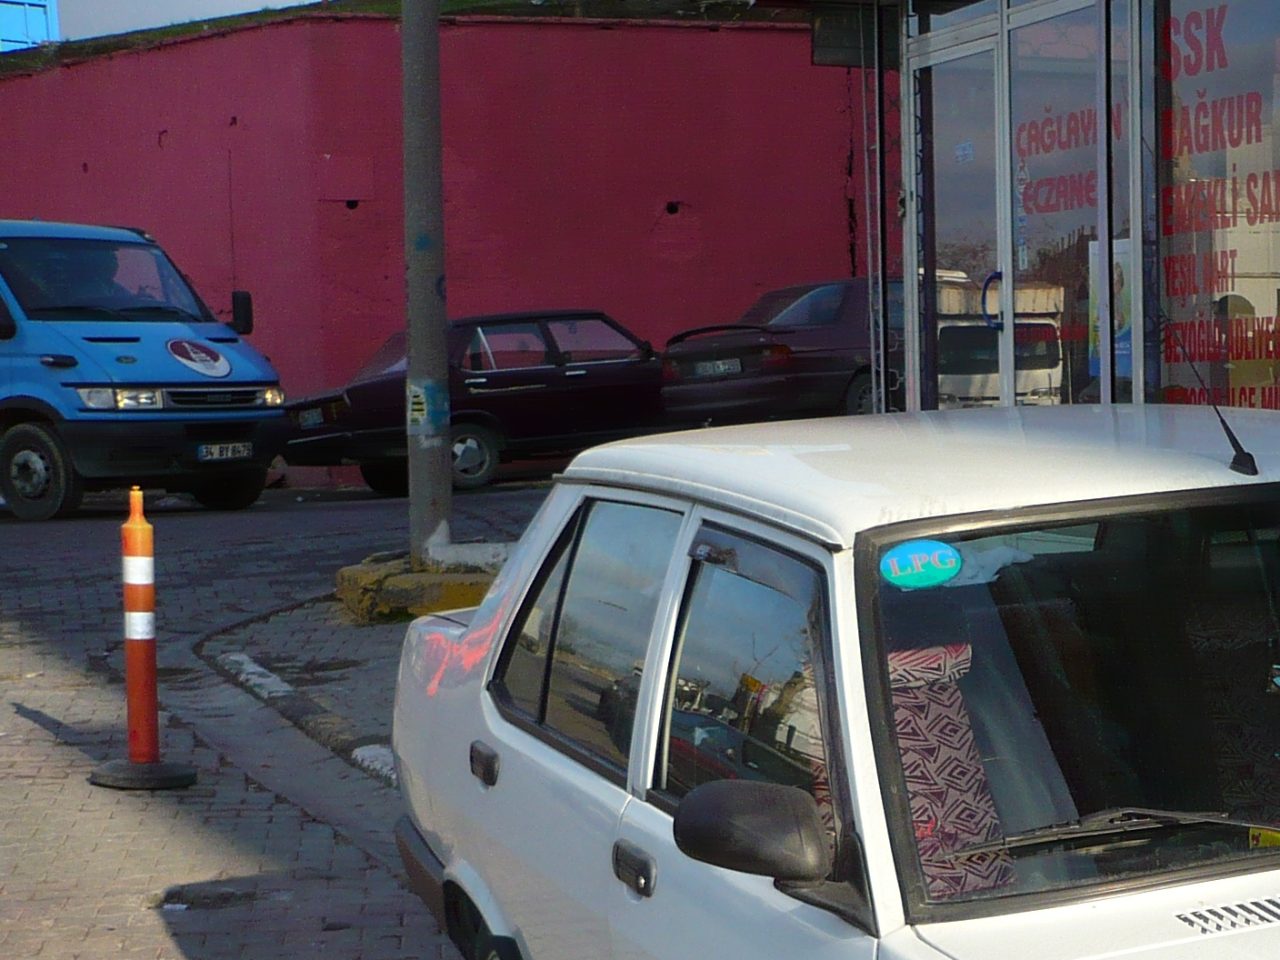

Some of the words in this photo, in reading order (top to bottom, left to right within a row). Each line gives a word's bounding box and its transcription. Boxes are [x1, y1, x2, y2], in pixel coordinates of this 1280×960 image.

[1162, 4, 1229, 83] SSK
[1015, 103, 1123, 158] ÇAĞLAYN
[1162, 163, 1238, 238] EMEKLİ
[886, 548, 957, 577] LPG
